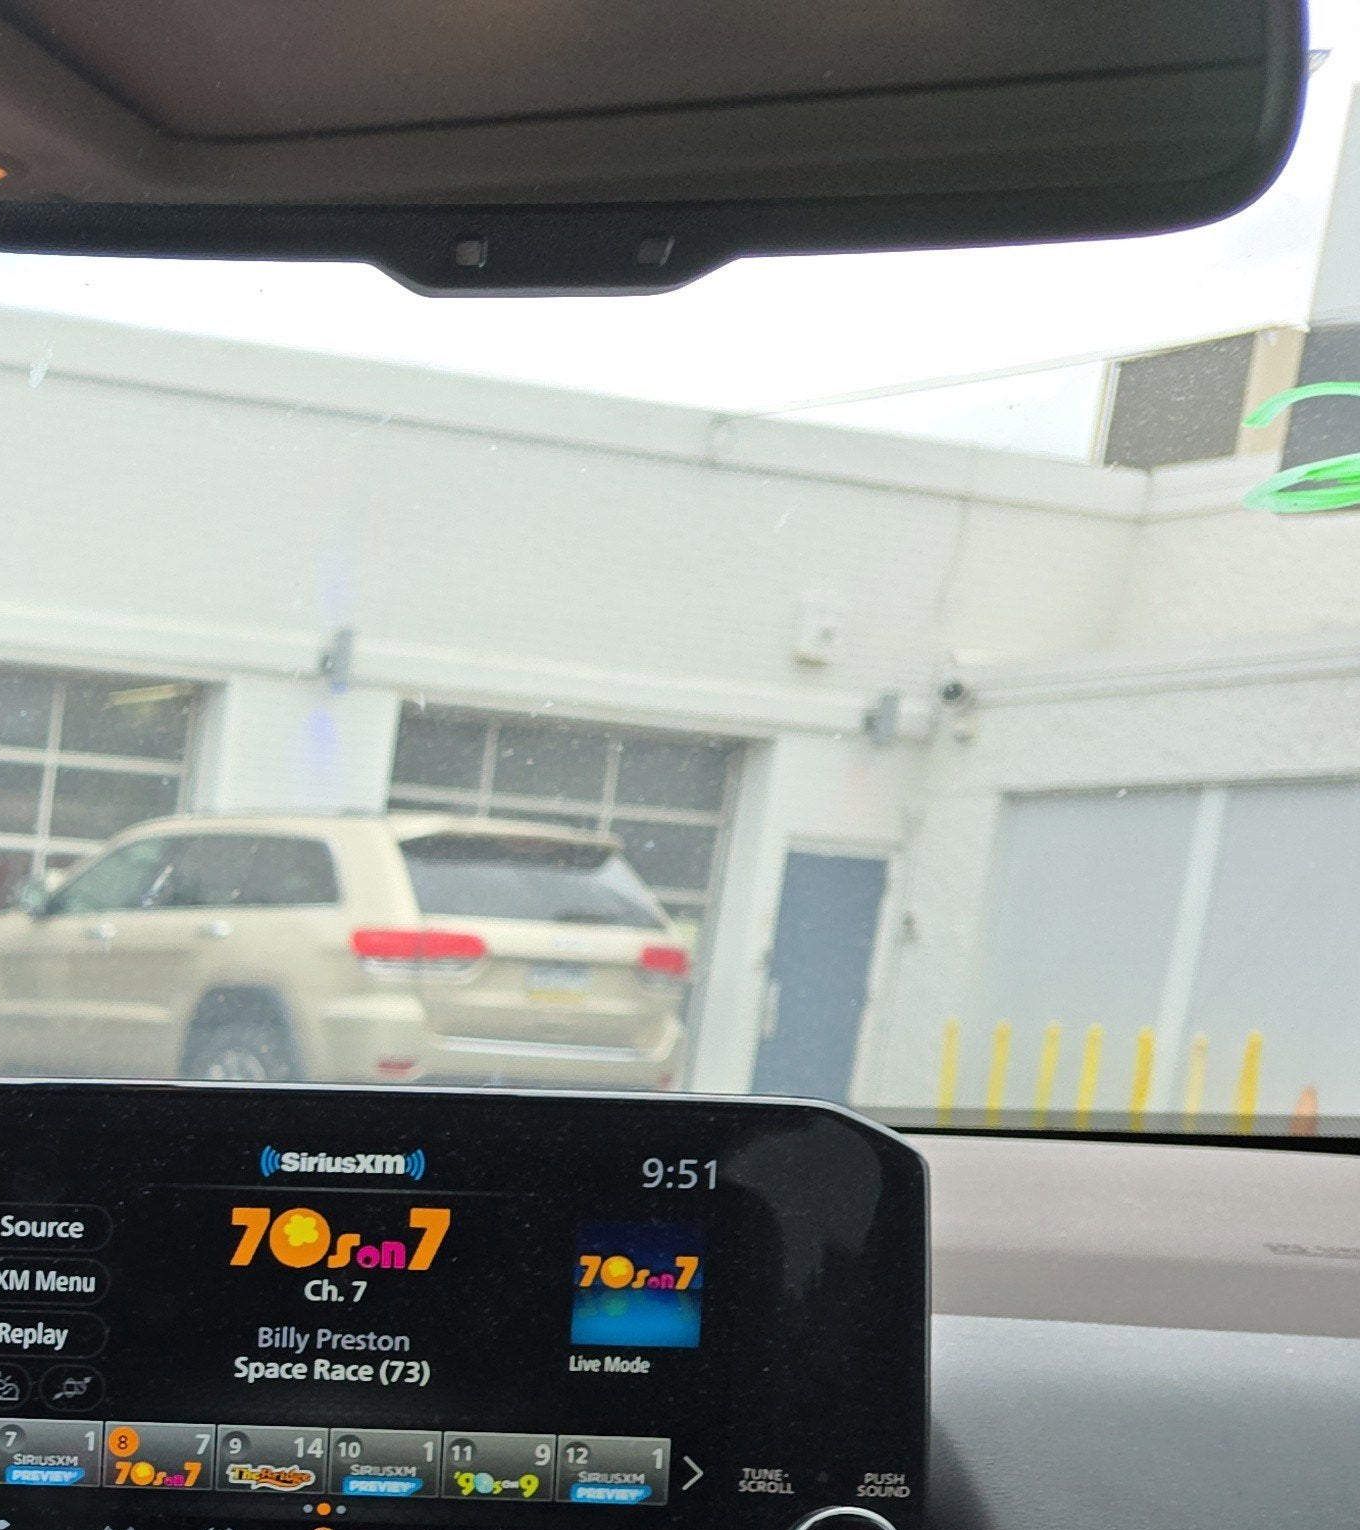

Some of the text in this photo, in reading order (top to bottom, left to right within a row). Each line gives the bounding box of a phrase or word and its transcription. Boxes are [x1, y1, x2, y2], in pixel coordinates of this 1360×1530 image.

[642, 1158, 718, 1190] 9:51
[0, 1215, 85, 1238] Source
[35, 1270, 96, 1293] Menu
[304, 1279, 367, 1302] Ch. 7
[258, 1326, 410, 1354] Billy Preston
[234, 1356, 431, 1387] Space Race (73)
[569, 1355, 650, 1374] Live Mode
[5, 1431, 17, 1447] 7
[84, 1431, 95, 1452] 1
[117, 1435, 128, 1450] 8
[195, 1434, 211, 1456] 7
[229, 1438, 242, 1455] 9
[294, 1437, 324, 1459] 14
[338, 1441, 361, 1458] 10
[422, 1441, 434, 1462] 1
[451, 1445, 472, 1462] 11
[534, 1443, 551, 1466] 9
[566, 1447, 589, 1465] 12
[652, 1448, 664, 1469] 1
[738, 1480, 795, 1494] SCROLL
[864, 1473, 906, 1485] PUSH
[857, 1485, 911, 1498] SOUND
